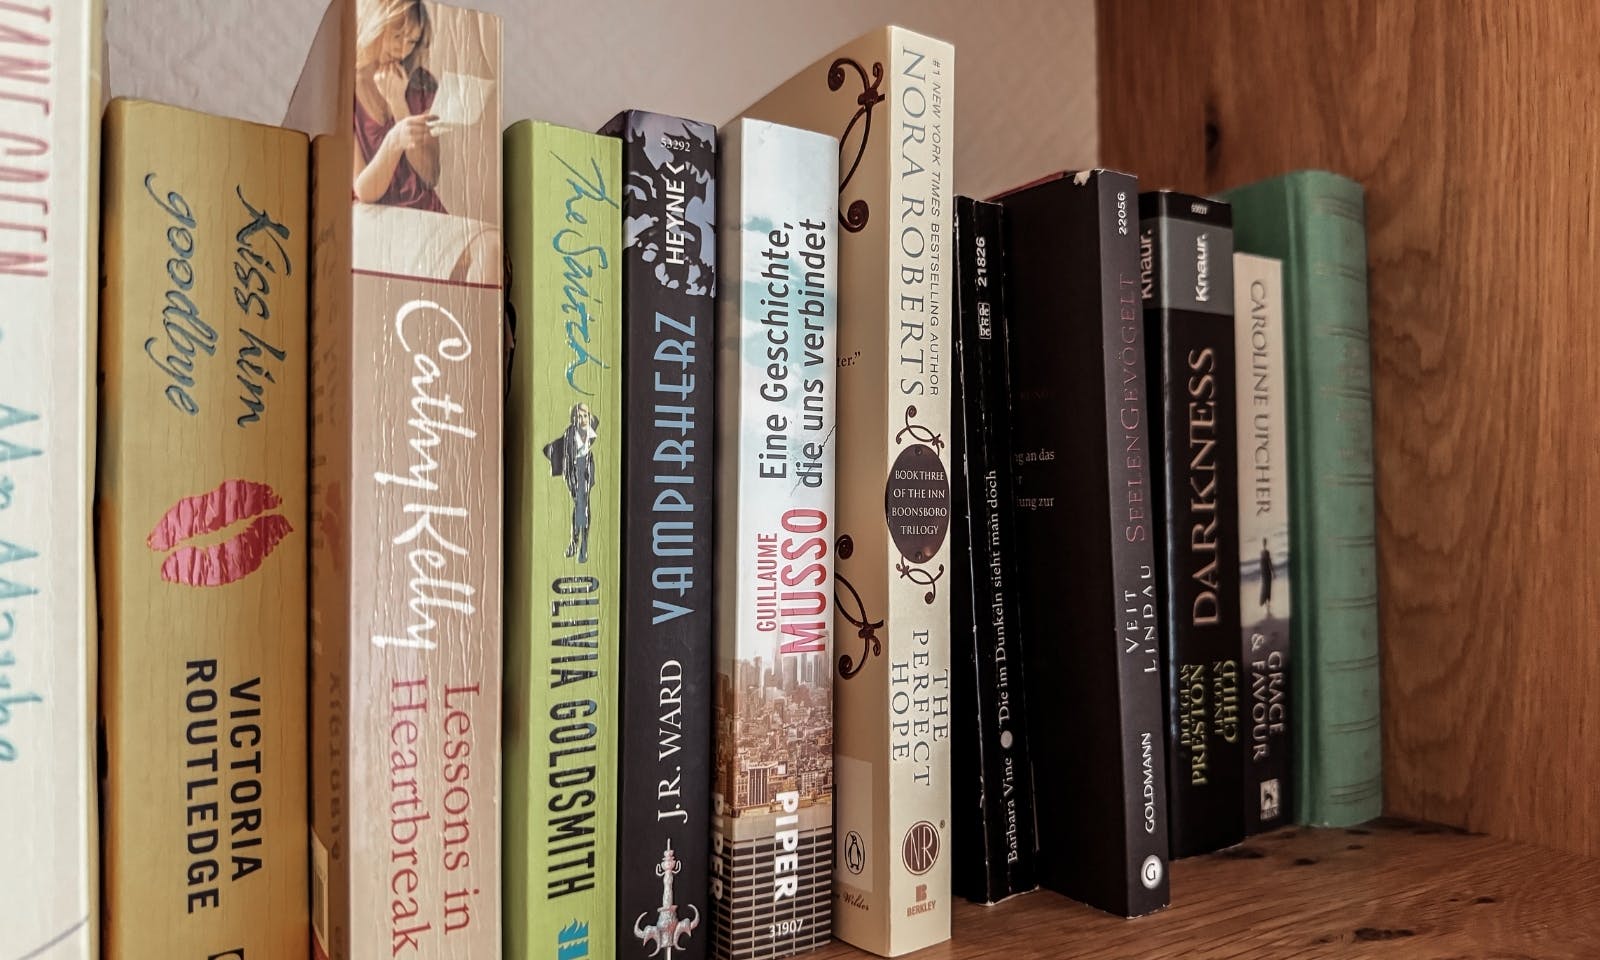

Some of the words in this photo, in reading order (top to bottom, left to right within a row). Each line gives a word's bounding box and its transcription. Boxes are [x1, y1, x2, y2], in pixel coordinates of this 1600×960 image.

[902, 45, 926, 180] NORA
[931, 82, 942, 119] NEW
[931, 124, 942, 166] YORK
[930, 171, 941, 217] TIMES
[1117, 191, 1127, 236] 22056
[144, 172, 218, 416] goodbye
[797, 217, 827, 368] verbindet
[900, 192, 926, 397] ROBERTS
[929, 223, 940, 327] BESTSELLING
[975, 235, 988, 288] 21826
[759, 222, 796, 403] Geschichte,
[1249, 279, 1269, 406] CAROLINE
[236, 328, 287, 428] him
[373, 299, 477, 490] Cathy
[802, 378, 825, 431] uns
[929, 332, 939, 396] AUTHOR
[652, 310, 697, 626] VAMPIRHERZ
[758, 413, 789, 480] Eine
[795, 441, 823, 489] die
[895, 470, 919, 480] BOOK
[920, 470, 945, 481] THREE
[986, 470, 997, 507] doch
[1188, 346, 1219, 627] DARKNESS
[1253, 412, 1272, 517] UPCHER
[892, 507, 947, 517] BOONSBORO
[893, 488, 906, 498] OF
[907, 488, 926, 499] THE
[928, 489, 945, 499] INN
[900, 525, 939, 535] TRILOGY
[989, 511, 1000, 547] man
[371, 503, 476, 651] Kelly
[756, 532, 779, 632] GUILLAUME
[780, 508, 827, 655] MUSSO
[990, 552, 1002, 587] sieht
[550, 575, 600, 689] OLIVIA
[992, 592, 1006, 661] Dunkeln
[1124, 590, 1140, 654] VEIT
[1141, 565, 1158, 674] LINDAU
[659, 659, 683, 762] WARD
[891, 660, 910, 761] HOPE
[912, 629, 931, 786] PERFECT
[932, 668, 949, 742] THE
[996, 666, 1008, 687] im
[998, 692, 1010, 721] Die
[1222, 659, 1238, 743] CHILD
[1251, 660, 1268, 762] FAVOUR
[1267, 650, 1284, 736] GRACE
[1189, 664, 1207, 785] PRESTON
[185, 658, 220, 914] ROUTLEDGE
[229, 677, 262, 882] VICTORIA
[389, 676, 432, 956] Heartbreak
[442, 681, 480, 872] Lessons
[547, 699, 598, 900] GOLDSMITH
[657, 766, 688, 825] J.R.
[1003, 757, 1013, 798] Vine
[1141, 733, 1154, 834] GOLDMANN
[775, 789, 800, 902] PIPER
[1008, 798, 1019, 864] Barbara
[442, 886, 480, 936] in
[768, 918, 804, 938] 31907
[906, 900, 936, 917] BERKLEY
